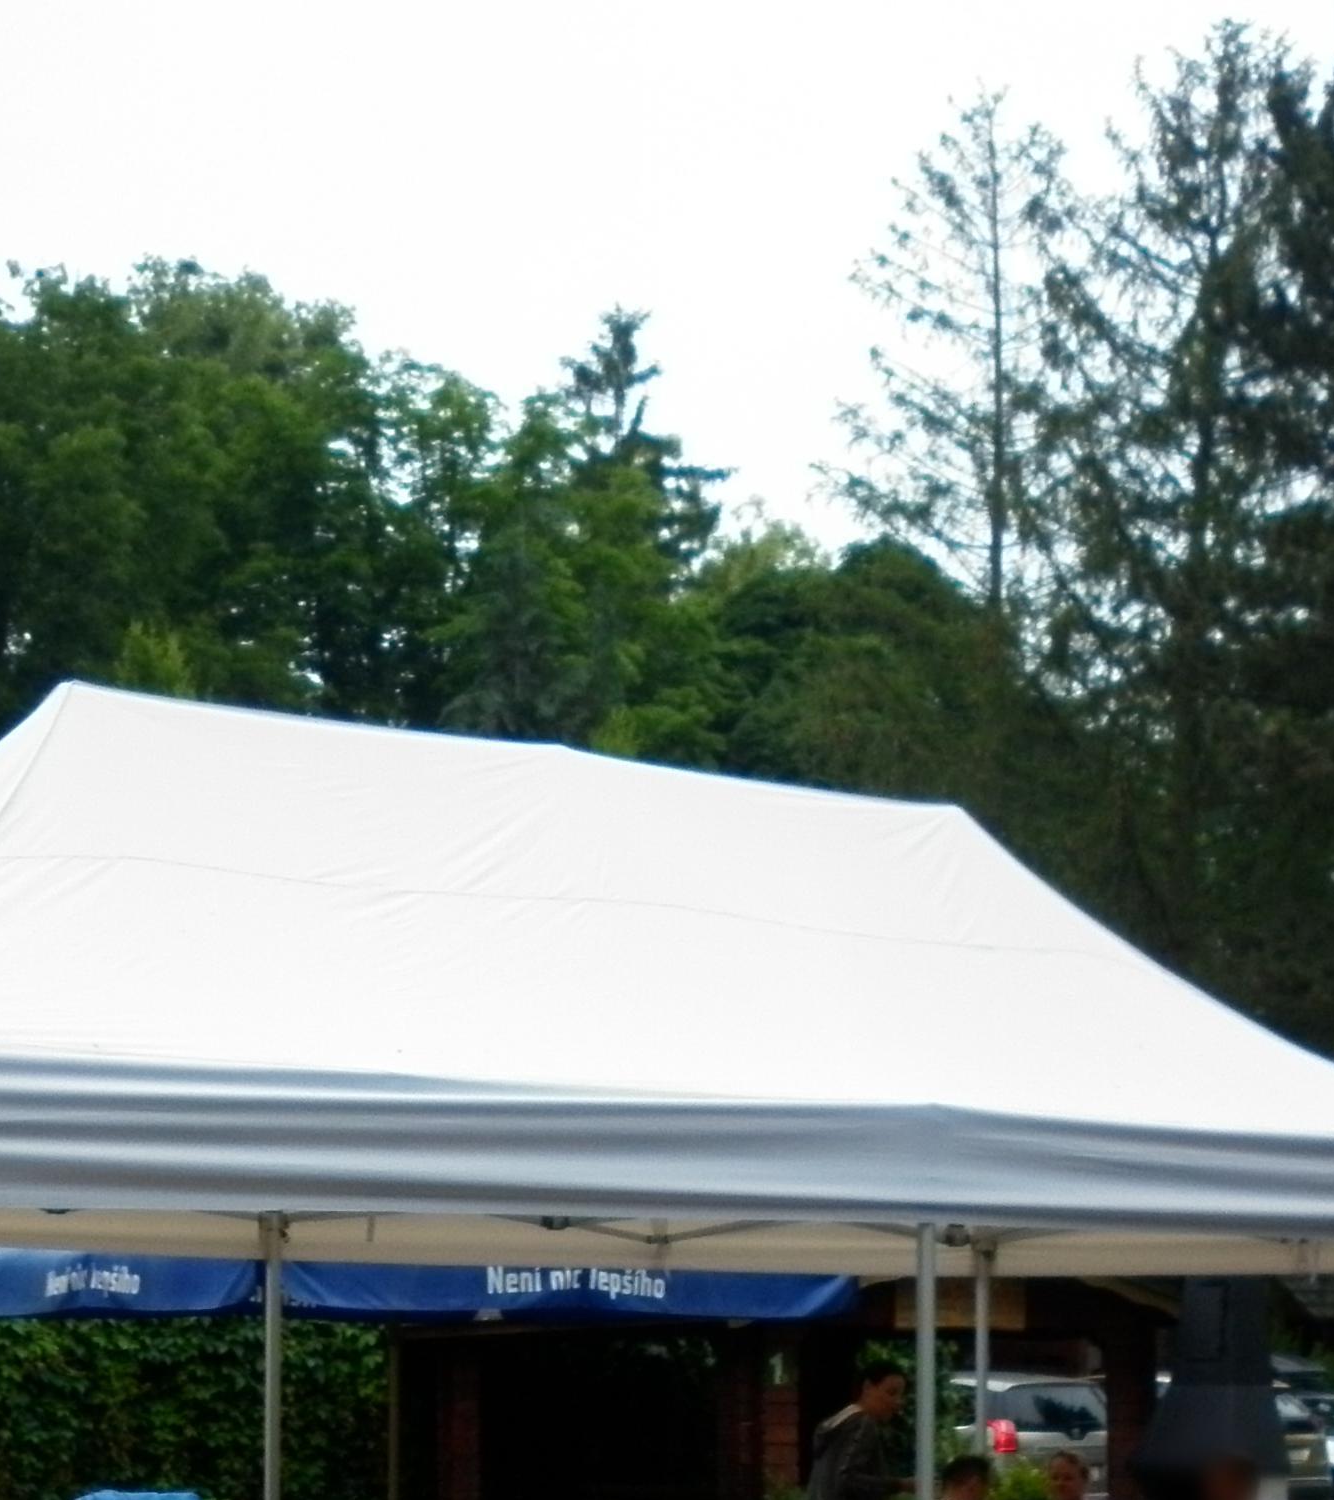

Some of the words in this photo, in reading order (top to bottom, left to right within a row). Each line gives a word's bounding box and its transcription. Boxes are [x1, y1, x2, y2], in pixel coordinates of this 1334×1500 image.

[486, 1265, 543, 1295] Není
[548, 1267, 582, 1292] nic
[589, 1267, 666, 1300] lepšího
